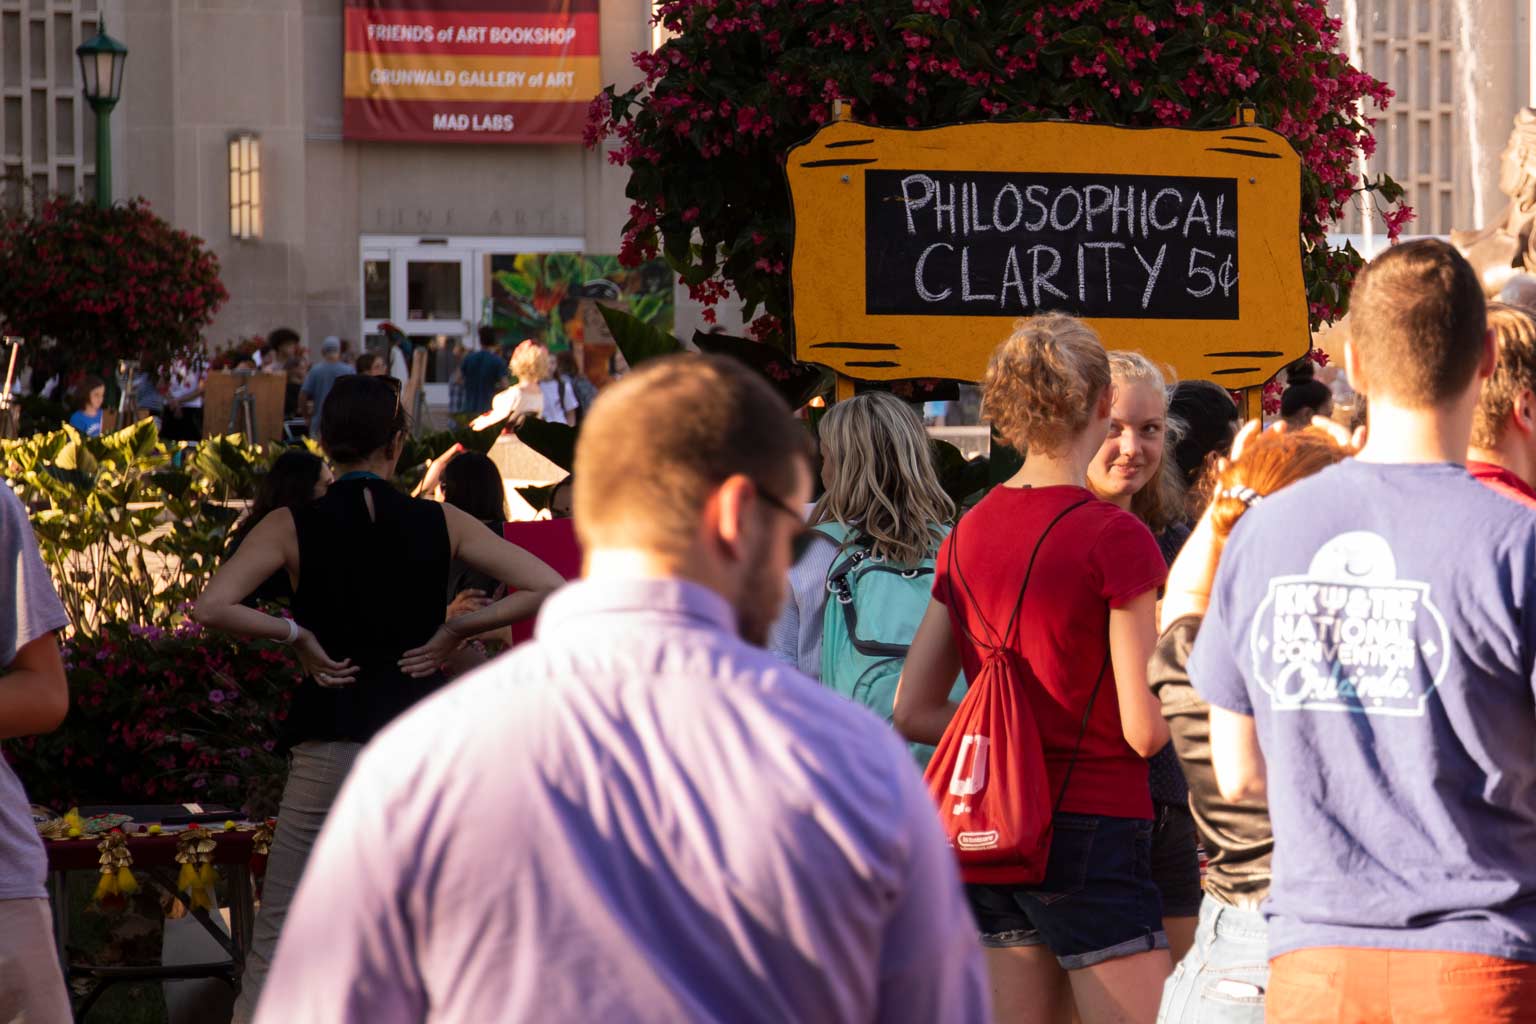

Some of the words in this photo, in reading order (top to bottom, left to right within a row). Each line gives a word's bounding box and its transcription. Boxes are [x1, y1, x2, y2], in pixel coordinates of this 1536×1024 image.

[368, 24, 434, 43] FRIENDS
[436, 25, 454, 43] of
[456, 26, 488, 43] ART
[490, 27, 576, 45] BOOKSHOP
[370, 68, 456, 87] GRUNWALD
[458, 70, 526, 88] GALLERY
[527, 72, 544, 88] of
[545, 72, 575, 88] ART
[433, 114, 469, 131] MAD
[472, 114, 514, 131] LABS
[901, 173, 1236, 238] PHILOSOPHICAL
[914, 242, 1167, 309] CLARITY
[1185, 248, 1239, 298] 5¢
[1273, 614, 1410, 645] NATIONAL
[1272, 639, 1415, 669] CONVENTION
